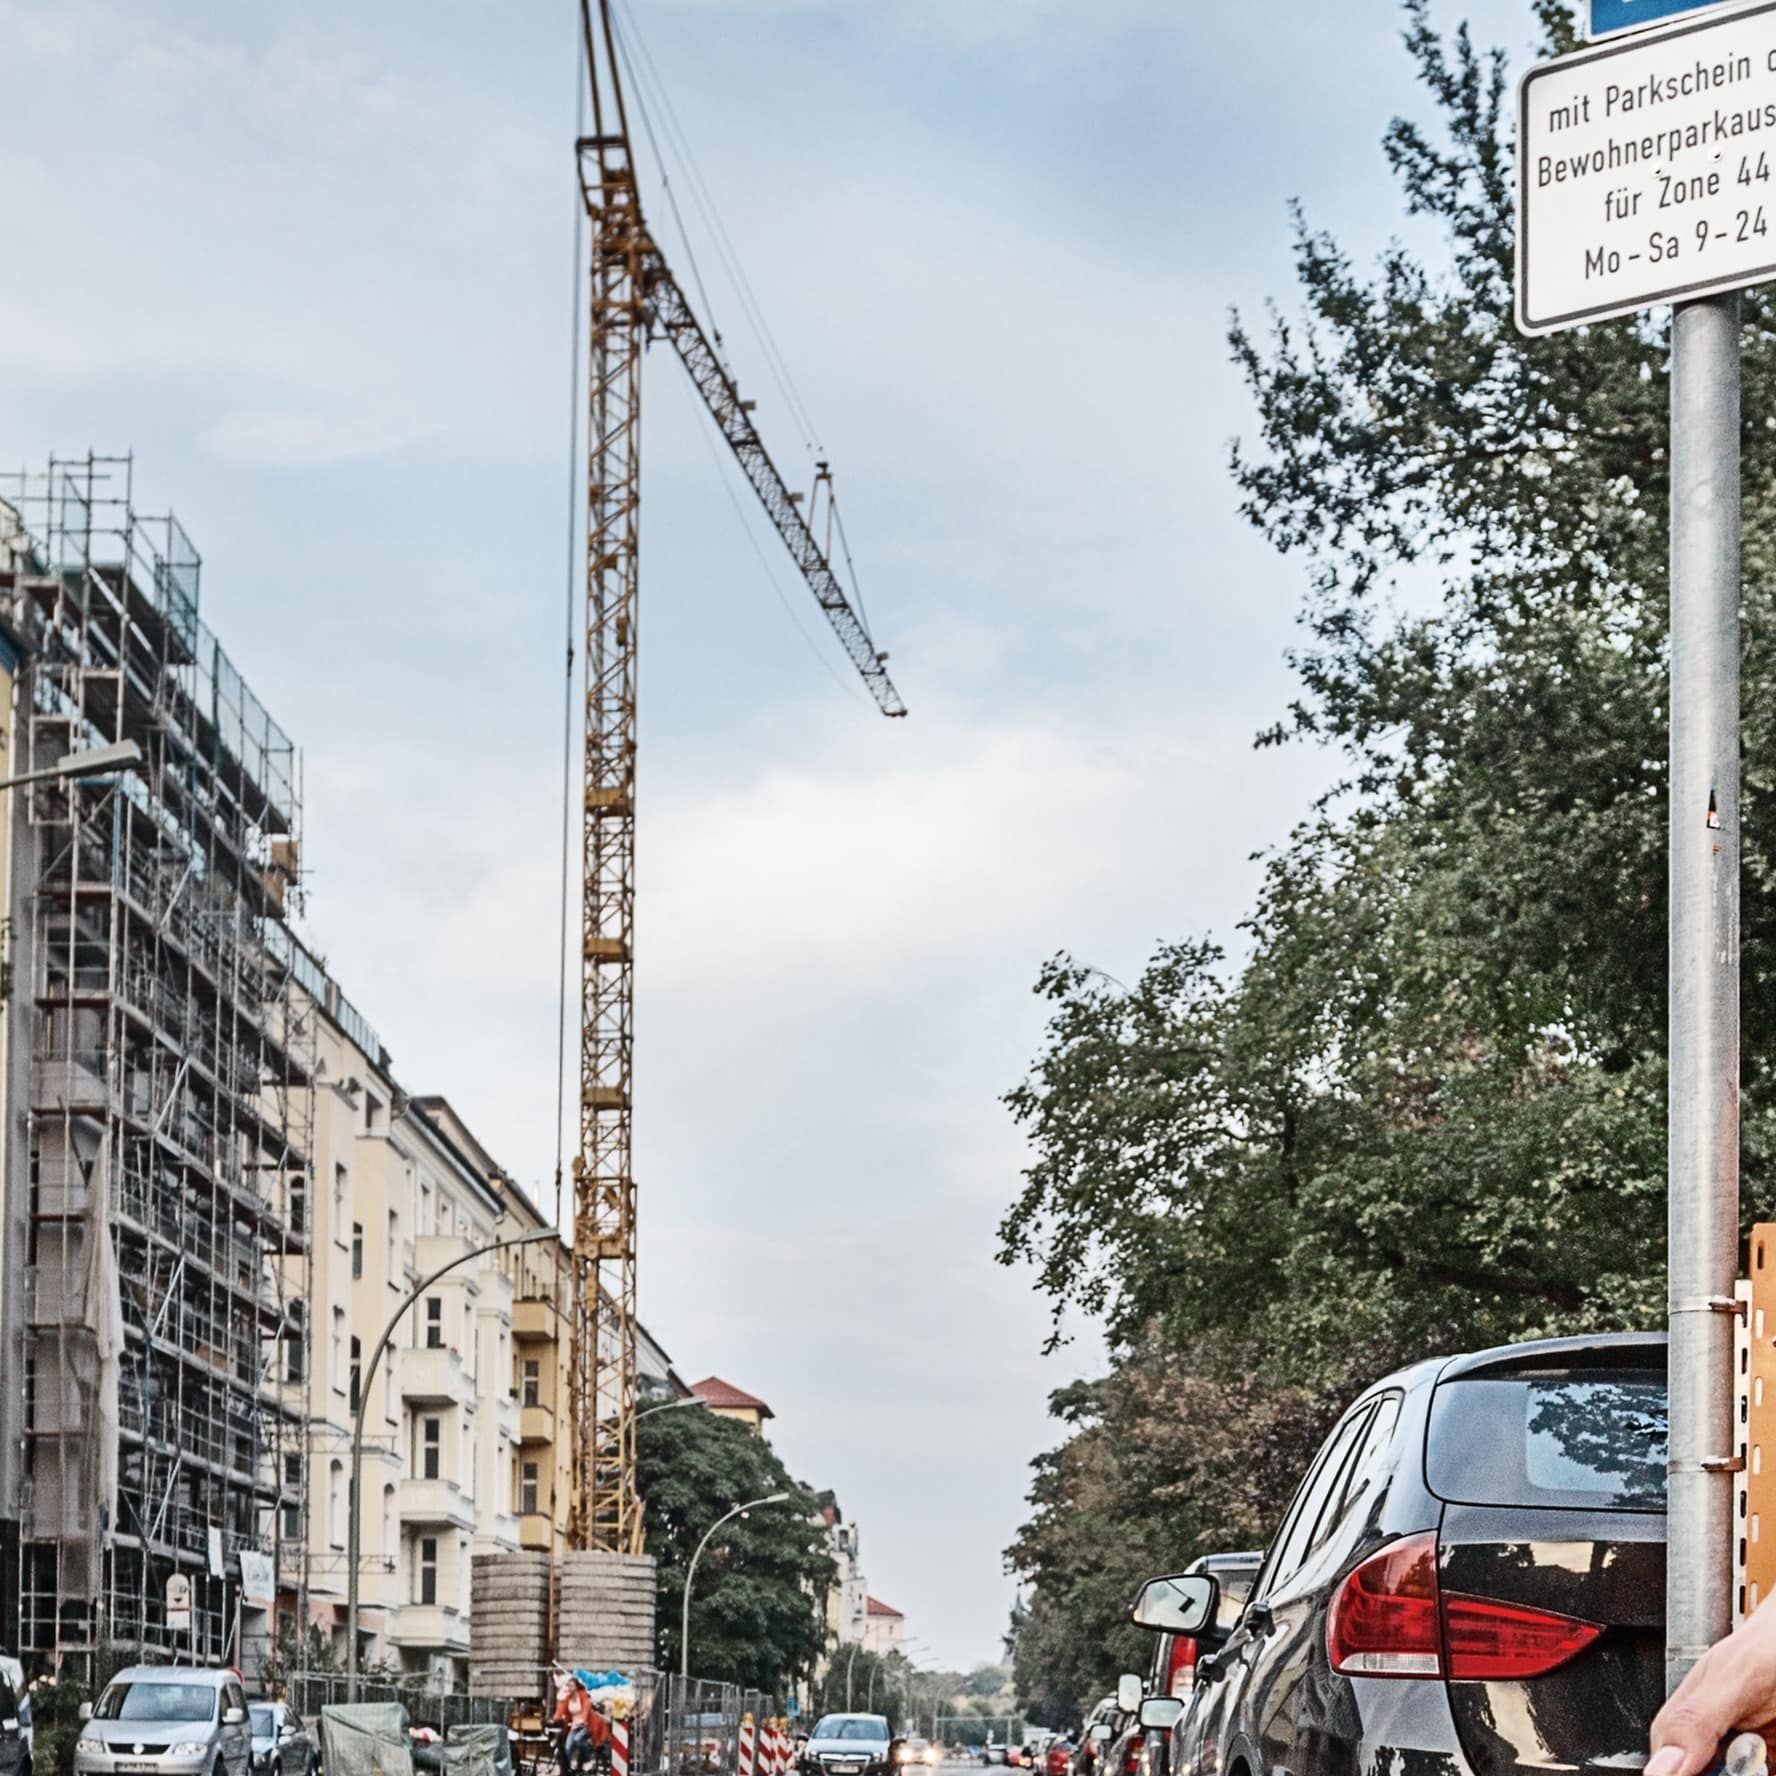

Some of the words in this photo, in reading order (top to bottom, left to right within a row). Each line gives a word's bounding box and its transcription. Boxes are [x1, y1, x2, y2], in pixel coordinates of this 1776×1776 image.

[1549, 95, 1590, 133] mit
[1606, 53, 1750, 117] Parkschein
[1605, 189, 1642, 222] für
[1658, 173, 1721, 209] Zone
[1737, 151, 1770, 187] 44
